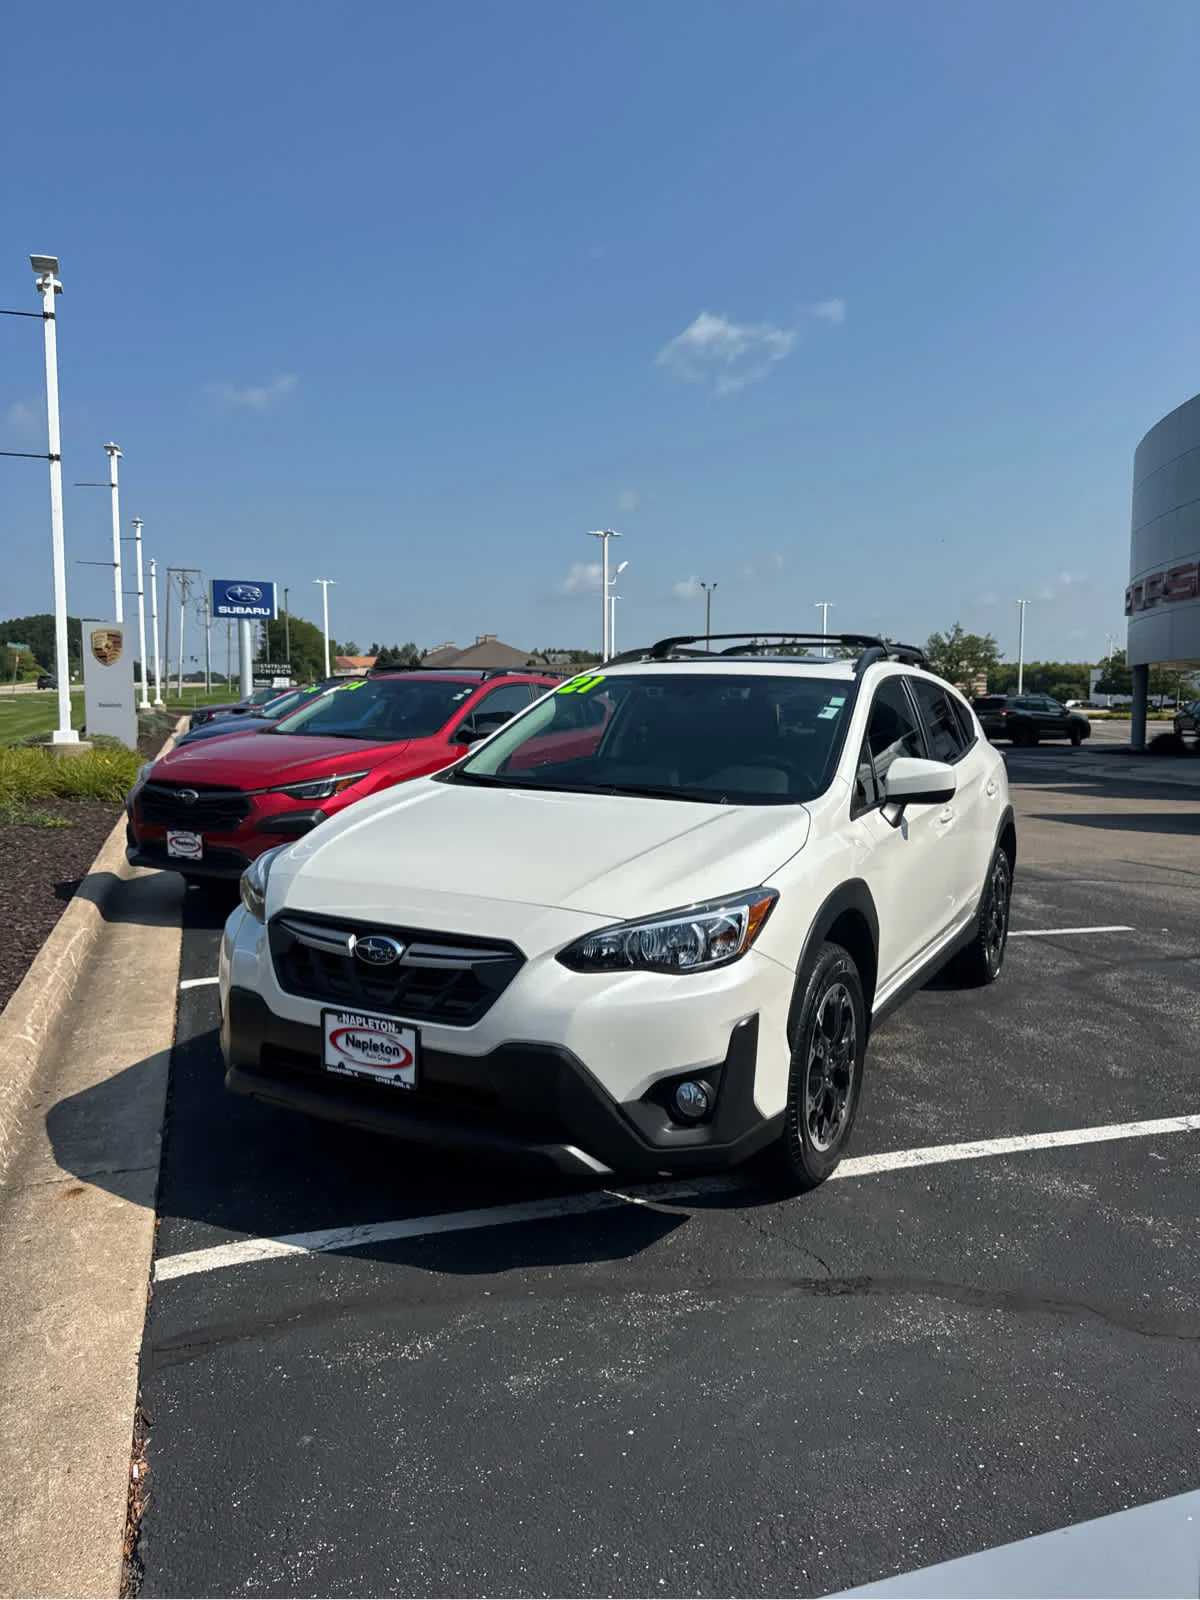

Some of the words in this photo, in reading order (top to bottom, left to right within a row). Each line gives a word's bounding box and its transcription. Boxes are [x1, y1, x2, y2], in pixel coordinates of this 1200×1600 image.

[218, 606, 271, 616] SUBARU
[557, 675, 606, 694] 21
[342, 1013, 396, 1033] NAPLETON
[345, 1033, 400, 1057] Napleton
